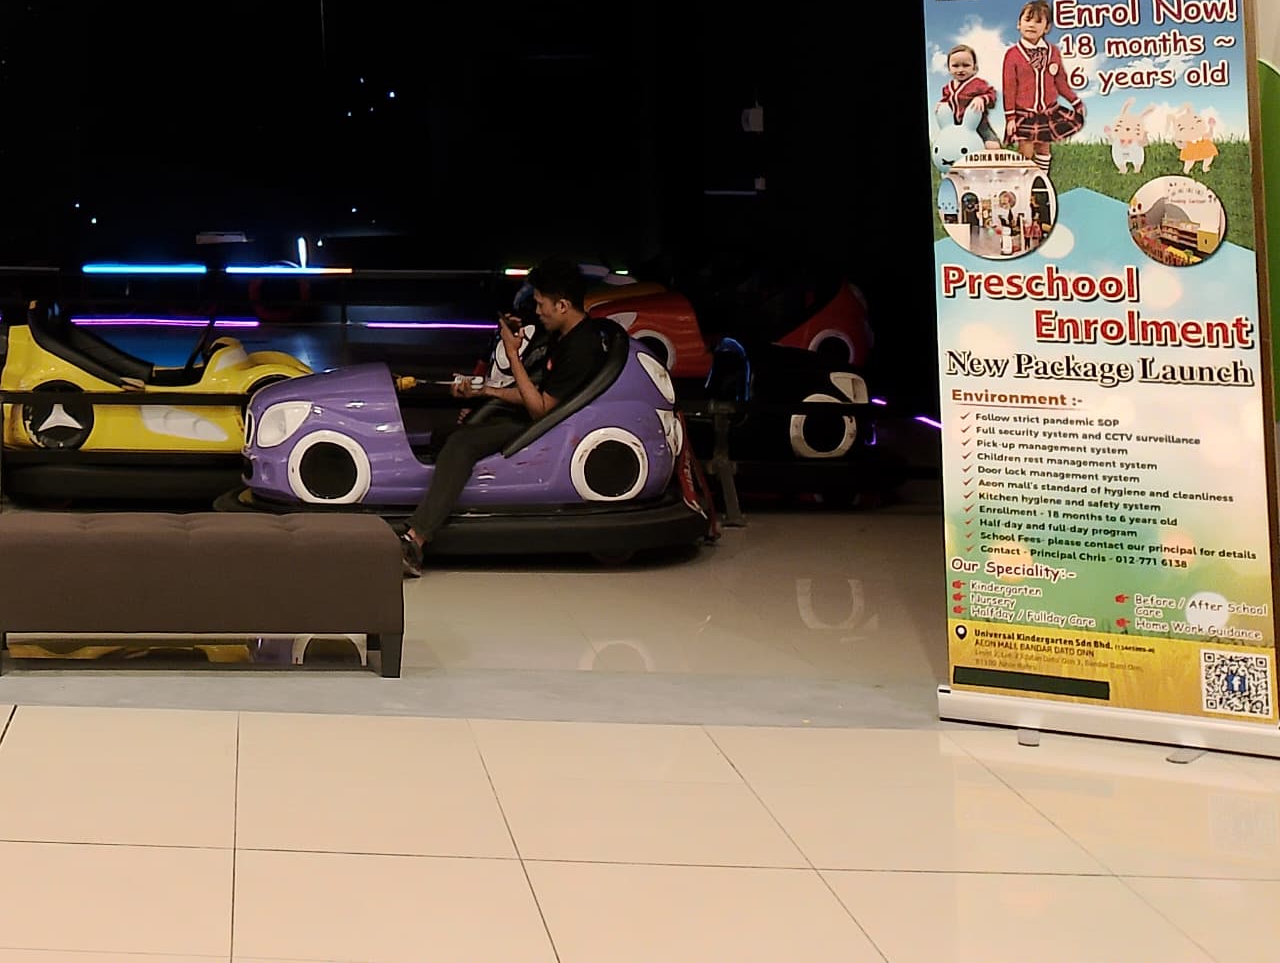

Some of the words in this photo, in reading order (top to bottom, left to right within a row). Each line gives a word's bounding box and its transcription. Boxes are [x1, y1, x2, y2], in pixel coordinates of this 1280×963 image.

[1062, 35, 1095, 57] 18
[1106, 30, 1205, 56] months
[1070, 67, 1087, 88] 6
[1099, 67, 1175, 95] years
[1186, 60, 1229, 85] old
[941, 263, 1141, 302] Preschool
[1034, 309, 1255, 349] Enrolment
[945, 350, 1009, 378] New
[1014, 352, 1134, 387] Package
[1139, 356, 1255, 387] Launch
[951, 388, 1067, 406] Environment
[975, 414, 1010, 422] Follow
[1012, 416, 1040, 424] strict
[1042, 418, 1094, 426] pandemic
[1097, 418, 1119, 426] SOP
[976, 426, 995, 434] Full
[998, 428, 1038, 438] security
[1042, 430, 1078, 440] system
[1081, 432, 1100, 440] and
[1104, 432, 1132, 442] CCTV
[1135, 436, 1200, 444] surveillance
[976, 440, 1015, 450] Pick-up
[1018, 444, 1086, 452] management
[1090, 446, 1128, 456] system
[976, 452, 1020, 462] Children
[1023, 456, 1042, 464] rest
[1046, 458, 1116, 468] management
[1120, 462, 1157, 470] system
[977, 466, 1001, 474] Door
[1004, 466, 1026, 476] lock
[1029, 470, 1098, 480] management
[1102, 474, 1140, 482] system
[978, 480, 1004, 488] Aeon
[1007, 482, 1038, 490] mall's
[1041, 484, 1087, 494] standard
[1090, 486, 1100, 494] of
[1104, 486, 1146, 498] hygiene
[1149, 490, 1169, 498] and
[1172, 492, 1234, 502] cleanliness
[978, 492, 1018, 502] Kitchen
[1021, 494, 1062, 504] hygiene
[1064, 498, 1084, 506] and
[1088, 500, 1120, 510] safety
[1122, 502, 1160, 512] system
[979, 506, 1036, 516] Enrollment
[1047, 510, 1058, 518] 18
[1062, 512, 1102, 522] months
[1105, 514, 1116, 522] to
[1160, 518, 1178, 526] old
[980, 518, 1022, 530] Half-day
[1026, 522, 1044, 530] and
[1048, 524, 1088, 536] full-day
[1091, 528, 1137, 538] program
[980, 532, 1014, 542] School
[1047, 536, 1080, 546] please
[1084, 542, 1124, 550] contact
[1148, 544, 1196, 556] principal
[1200, 548, 1214, 556] for
[1218, 550, 1256, 560] details
[980, 544, 1020, 556] Contact
[1030, 548, 1076, 560] Principal
[1078, 552, 1106, 562] Chris
[1161, 558, 1187, 568] 6138
[951, 558, 978, 572] Our
[970, 579, 1041, 597] Kindergarten
[970, 594, 1015, 609] Nursery
[1134, 594, 1176, 608] Before
[1188, 598, 1222, 612] After
[1226, 601, 1268, 615] School
[970, 604, 1014, 621] Halfday
[1026, 610, 1066, 626] Fullday
[1068, 614, 1096, 628] Care
[1134, 606, 1163, 618] Care
[1134, 619, 1169, 633] Home
[1171, 622, 1203, 635] Work
[1207, 624, 1262, 639] Guidance
[974, 630, 1014, 640] Universal
[1016, 634, 1072, 646] Kindergarten
[1075, 638, 1090, 648] Sdn
[1094, 640, 1113, 650] Bhd.
[974, 638, 996, 648] AEON
[998, 642, 1018, 650] MALL
[1020, 644, 1052, 652] BANDAR
